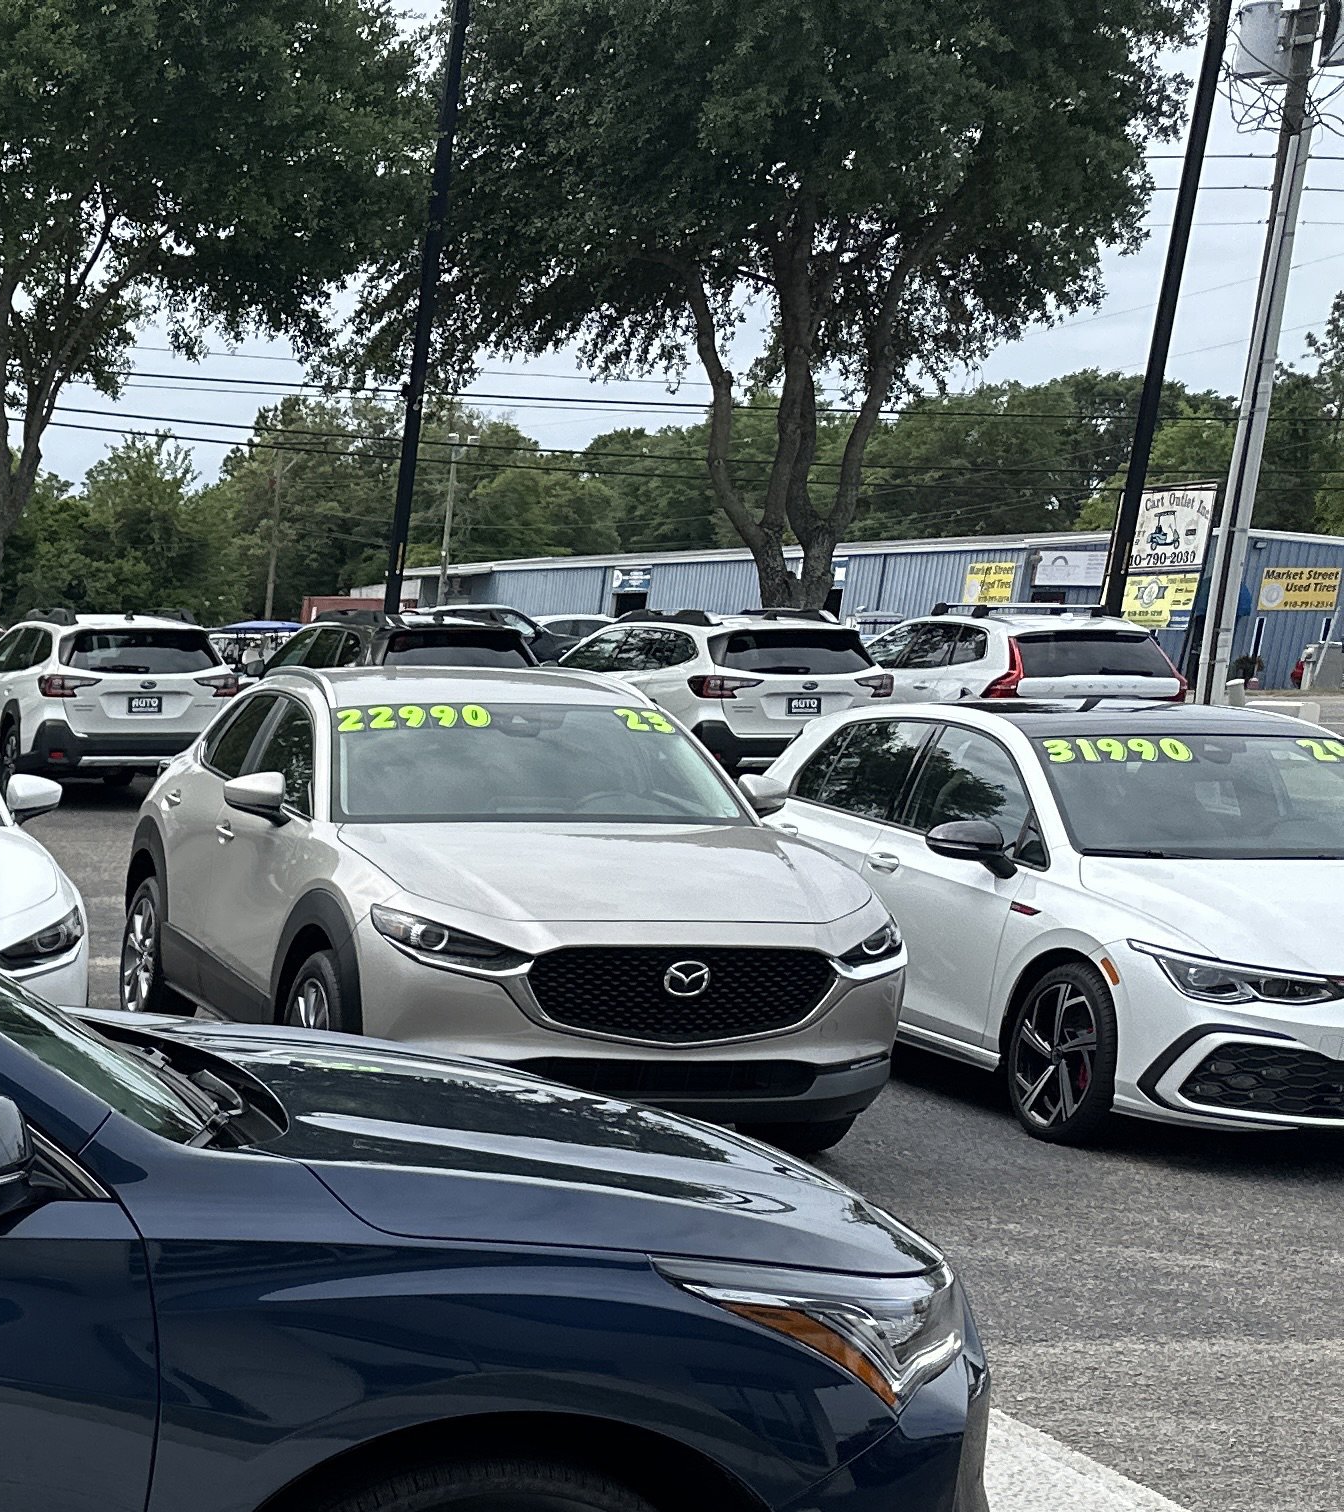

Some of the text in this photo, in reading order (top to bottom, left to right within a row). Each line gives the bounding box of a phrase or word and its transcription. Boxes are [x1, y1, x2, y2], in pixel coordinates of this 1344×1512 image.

[1145, 495, 1164, 511] Cart
[1169, 492, 1195, 509] Outlet
[1129, 550, 1196, 566] 10-790-2030
[1264, 569, 1340, 580] Market Street
[1285, 582, 1337, 592] Used Tires
[132, 697, 159, 707] AUTO
[791, 699, 818, 708] AUTO
[337, 705, 675, 733] 22990 23
[1043, 738, 1193, 762] 31990
